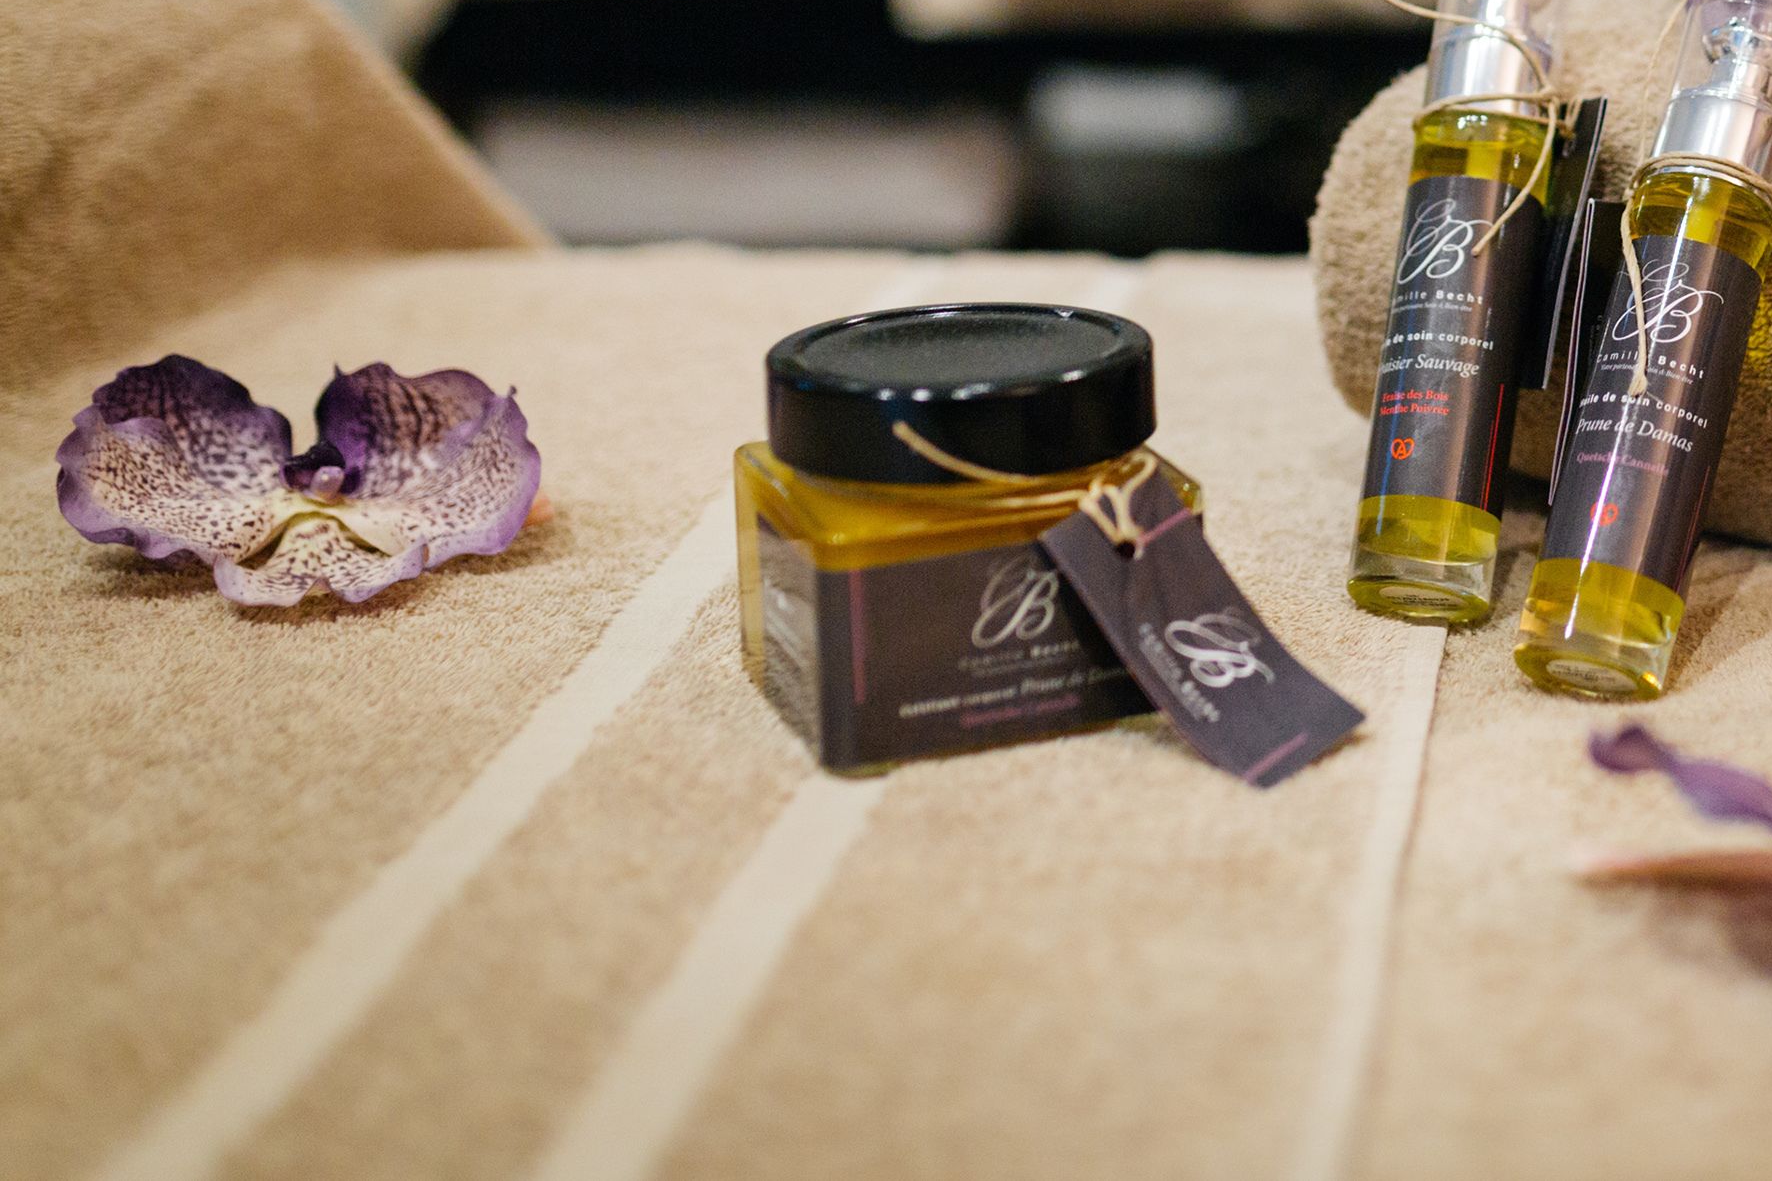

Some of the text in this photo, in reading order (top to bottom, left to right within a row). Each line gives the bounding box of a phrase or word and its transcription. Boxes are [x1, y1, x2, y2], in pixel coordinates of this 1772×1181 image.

[1435, 289, 1483, 305] Becht
[1407, 330, 1433, 342] soin
[1437, 333, 1494, 351] corporel
[1414, 353, 1480, 379] Sauvage
[1656, 355, 1705, 379] Becht
[1425, 388, 1449, 402] Bois
[1602, 391, 1617, 403] de
[1655, 399, 1709, 429] corporel
[1575, 418, 1695, 453] Prune de Damas
